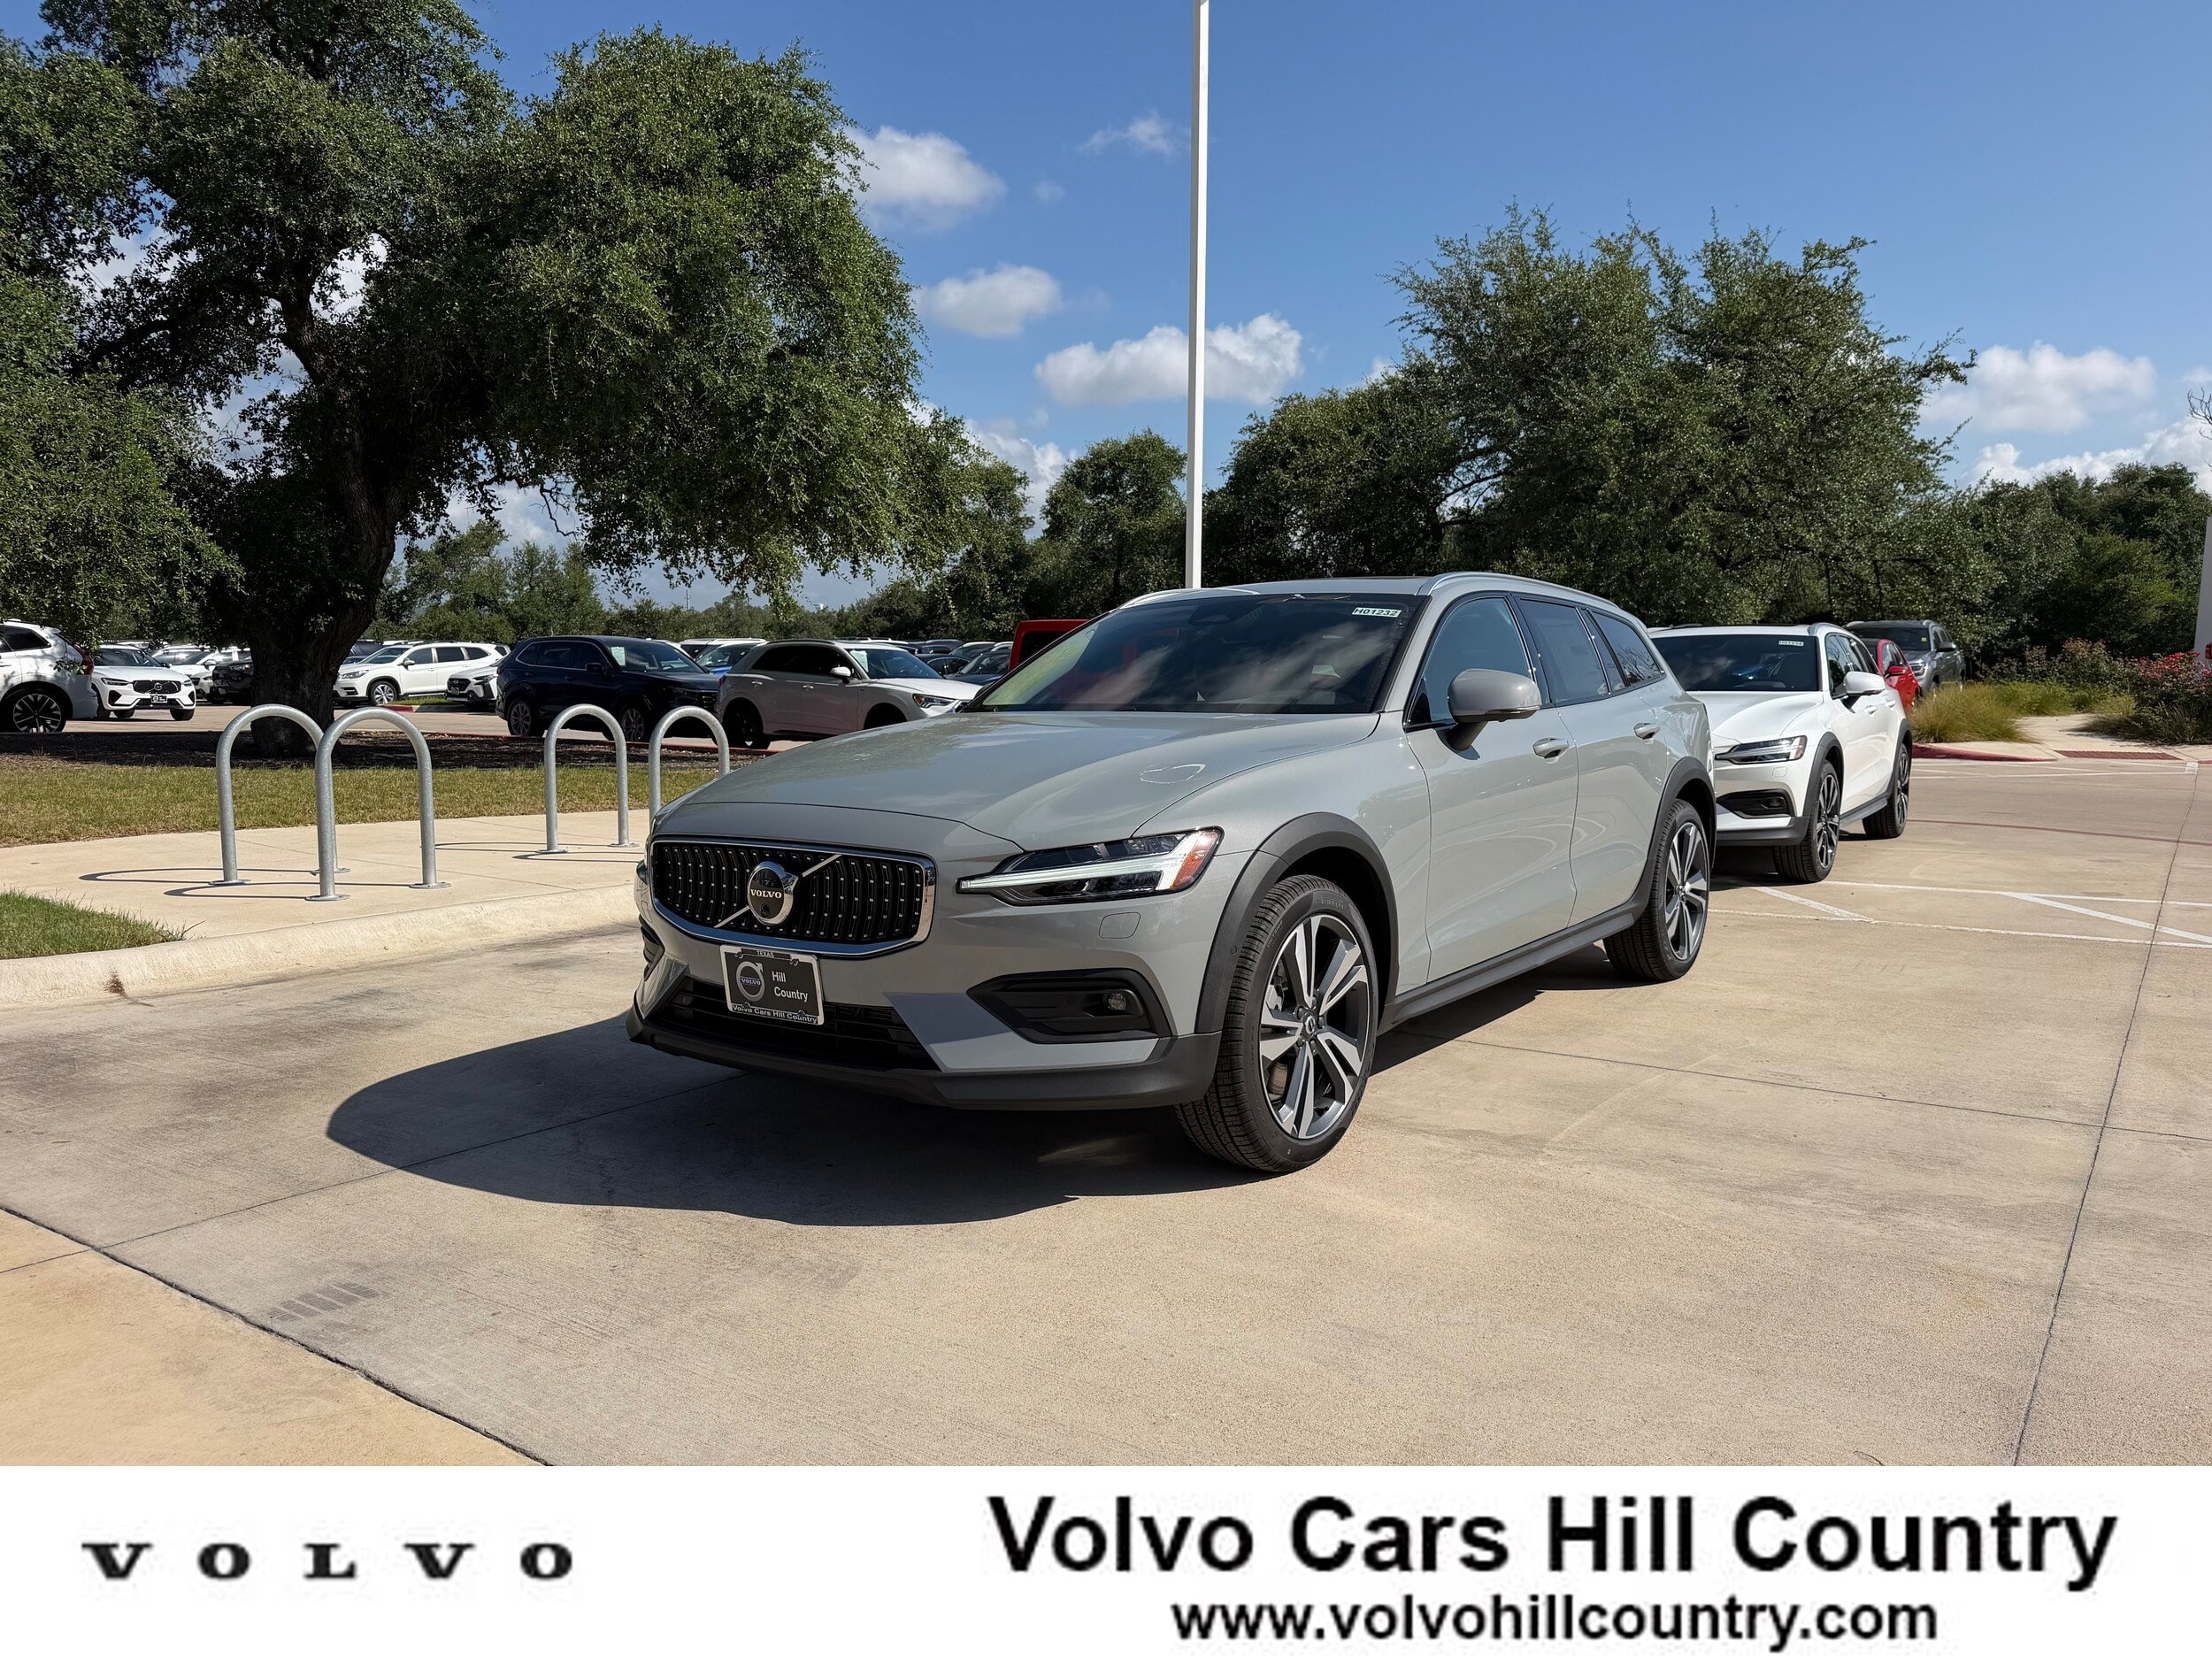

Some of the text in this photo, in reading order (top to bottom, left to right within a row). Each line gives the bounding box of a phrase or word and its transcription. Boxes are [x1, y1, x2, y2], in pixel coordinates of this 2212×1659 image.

[1354, 608, 1398, 617] H01232
[750, 888, 782, 899] VOLVO
[772, 971, 787, 983] Hill
[774, 986, 809, 1002] Country
[732, 1004, 753, 1013] Volvo
[754, 1008, 772, 1017] Cars
[787, 1013, 818, 1024] Country
